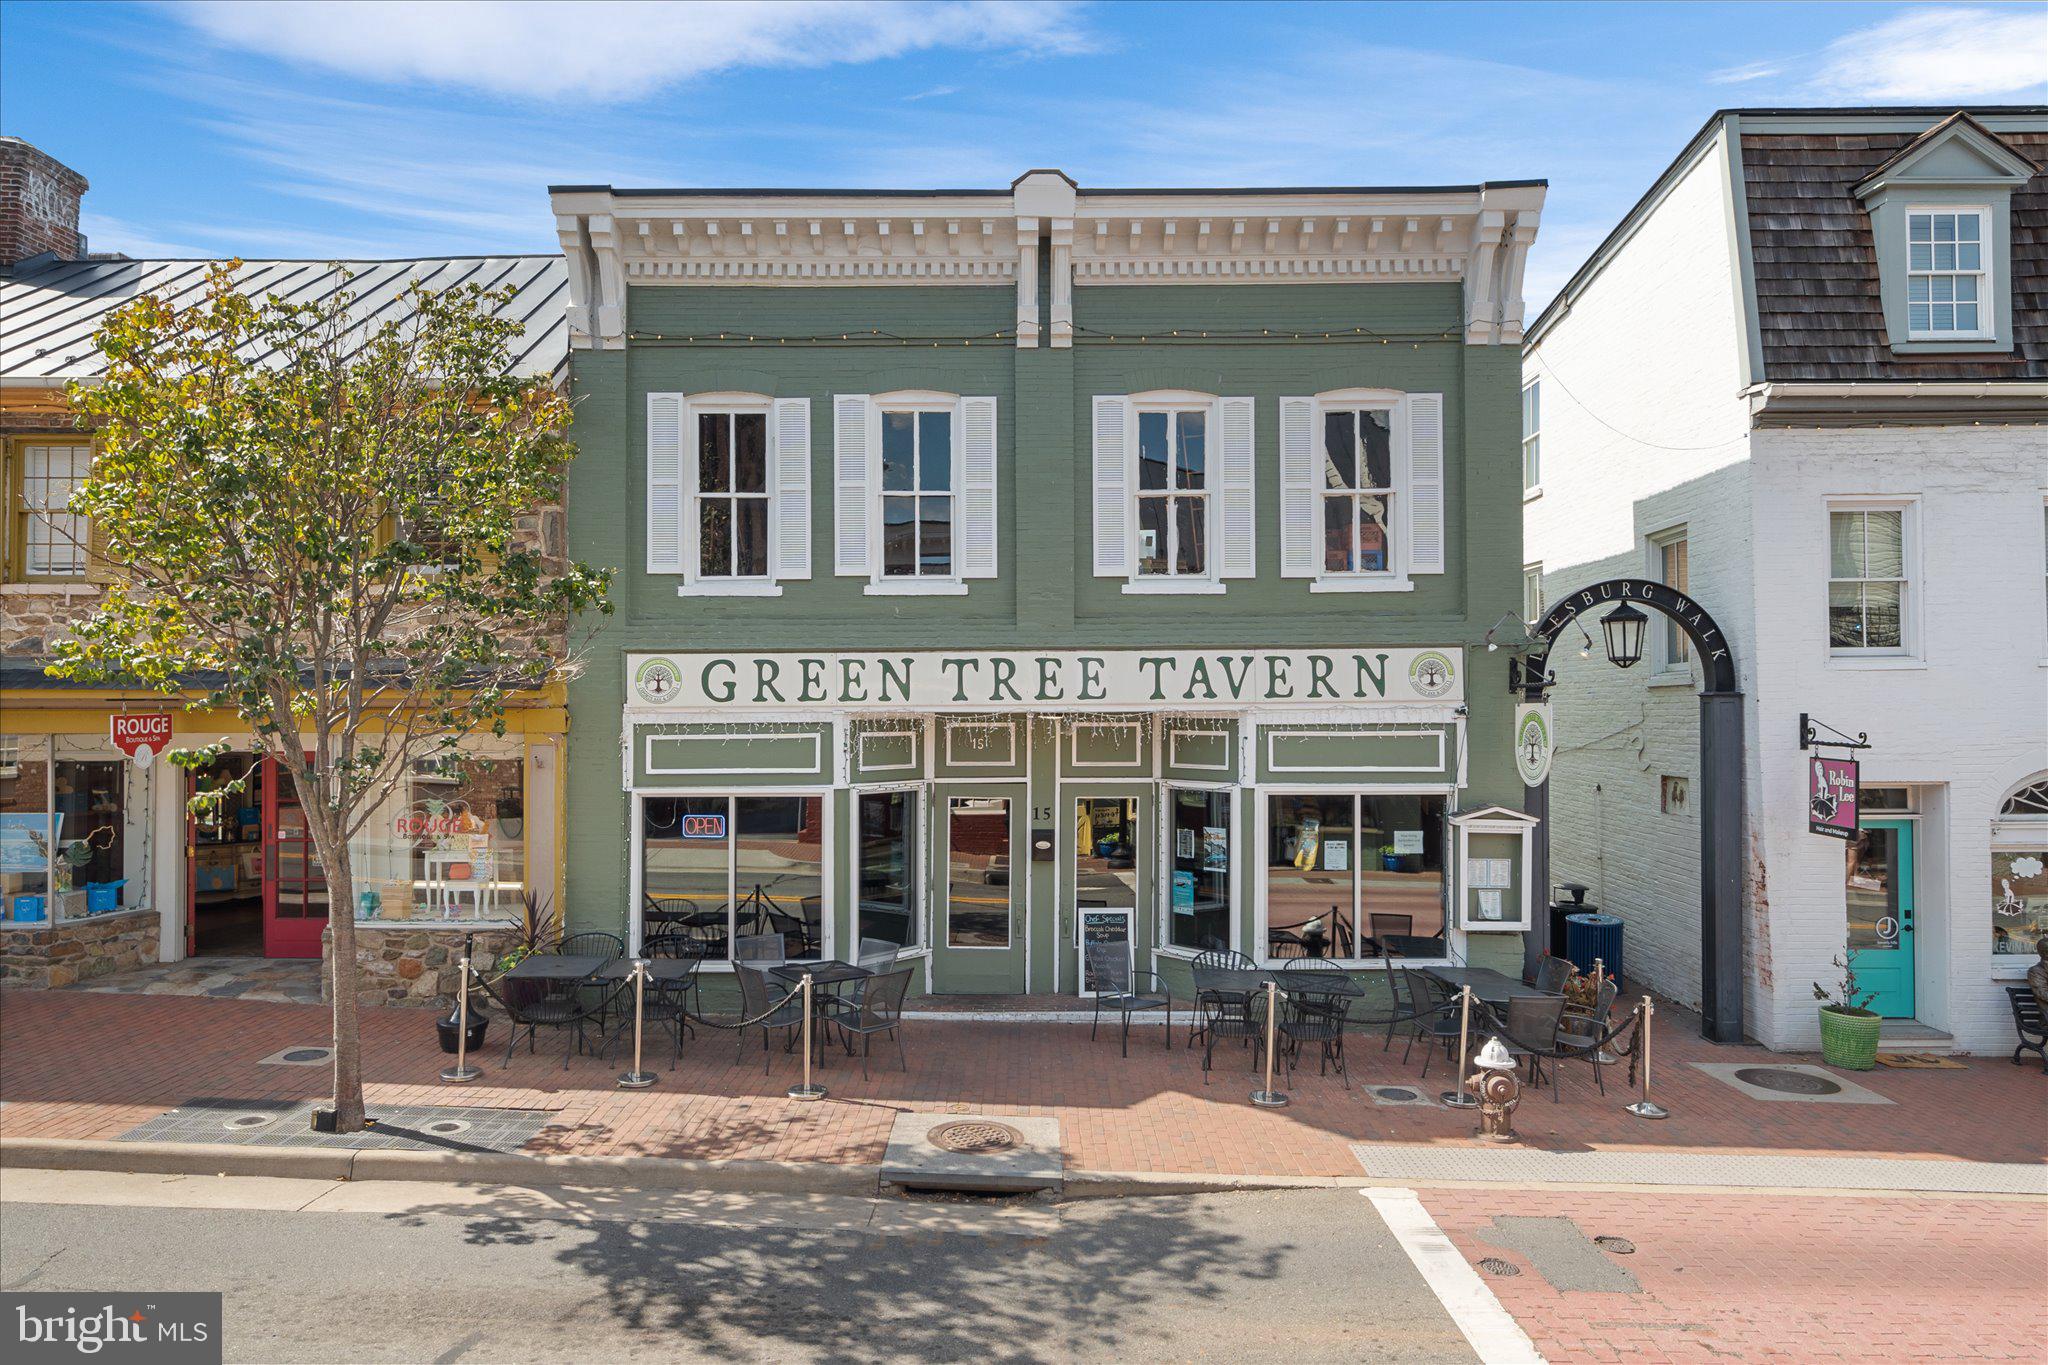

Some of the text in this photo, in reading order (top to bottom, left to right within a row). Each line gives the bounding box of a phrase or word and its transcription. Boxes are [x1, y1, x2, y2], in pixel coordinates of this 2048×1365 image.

[1529, 581, 1727, 662] LESBURG WALK
[700, 657, 915, 703] GREEN
[941, 656, 1107, 702] TREE
[1138, 653, 1390, 700] TAVERN
[117, 717, 169, 736] ROUGE
[972, 738, 984, 750] 15
[1828, 769, 1855, 788] Robin
[1839, 786, 1855, 803] Lee
[1032, 806, 1051, 821] 15
[397, 817, 463, 834] ROUGE
[685, 817, 723, 835] OPEN
